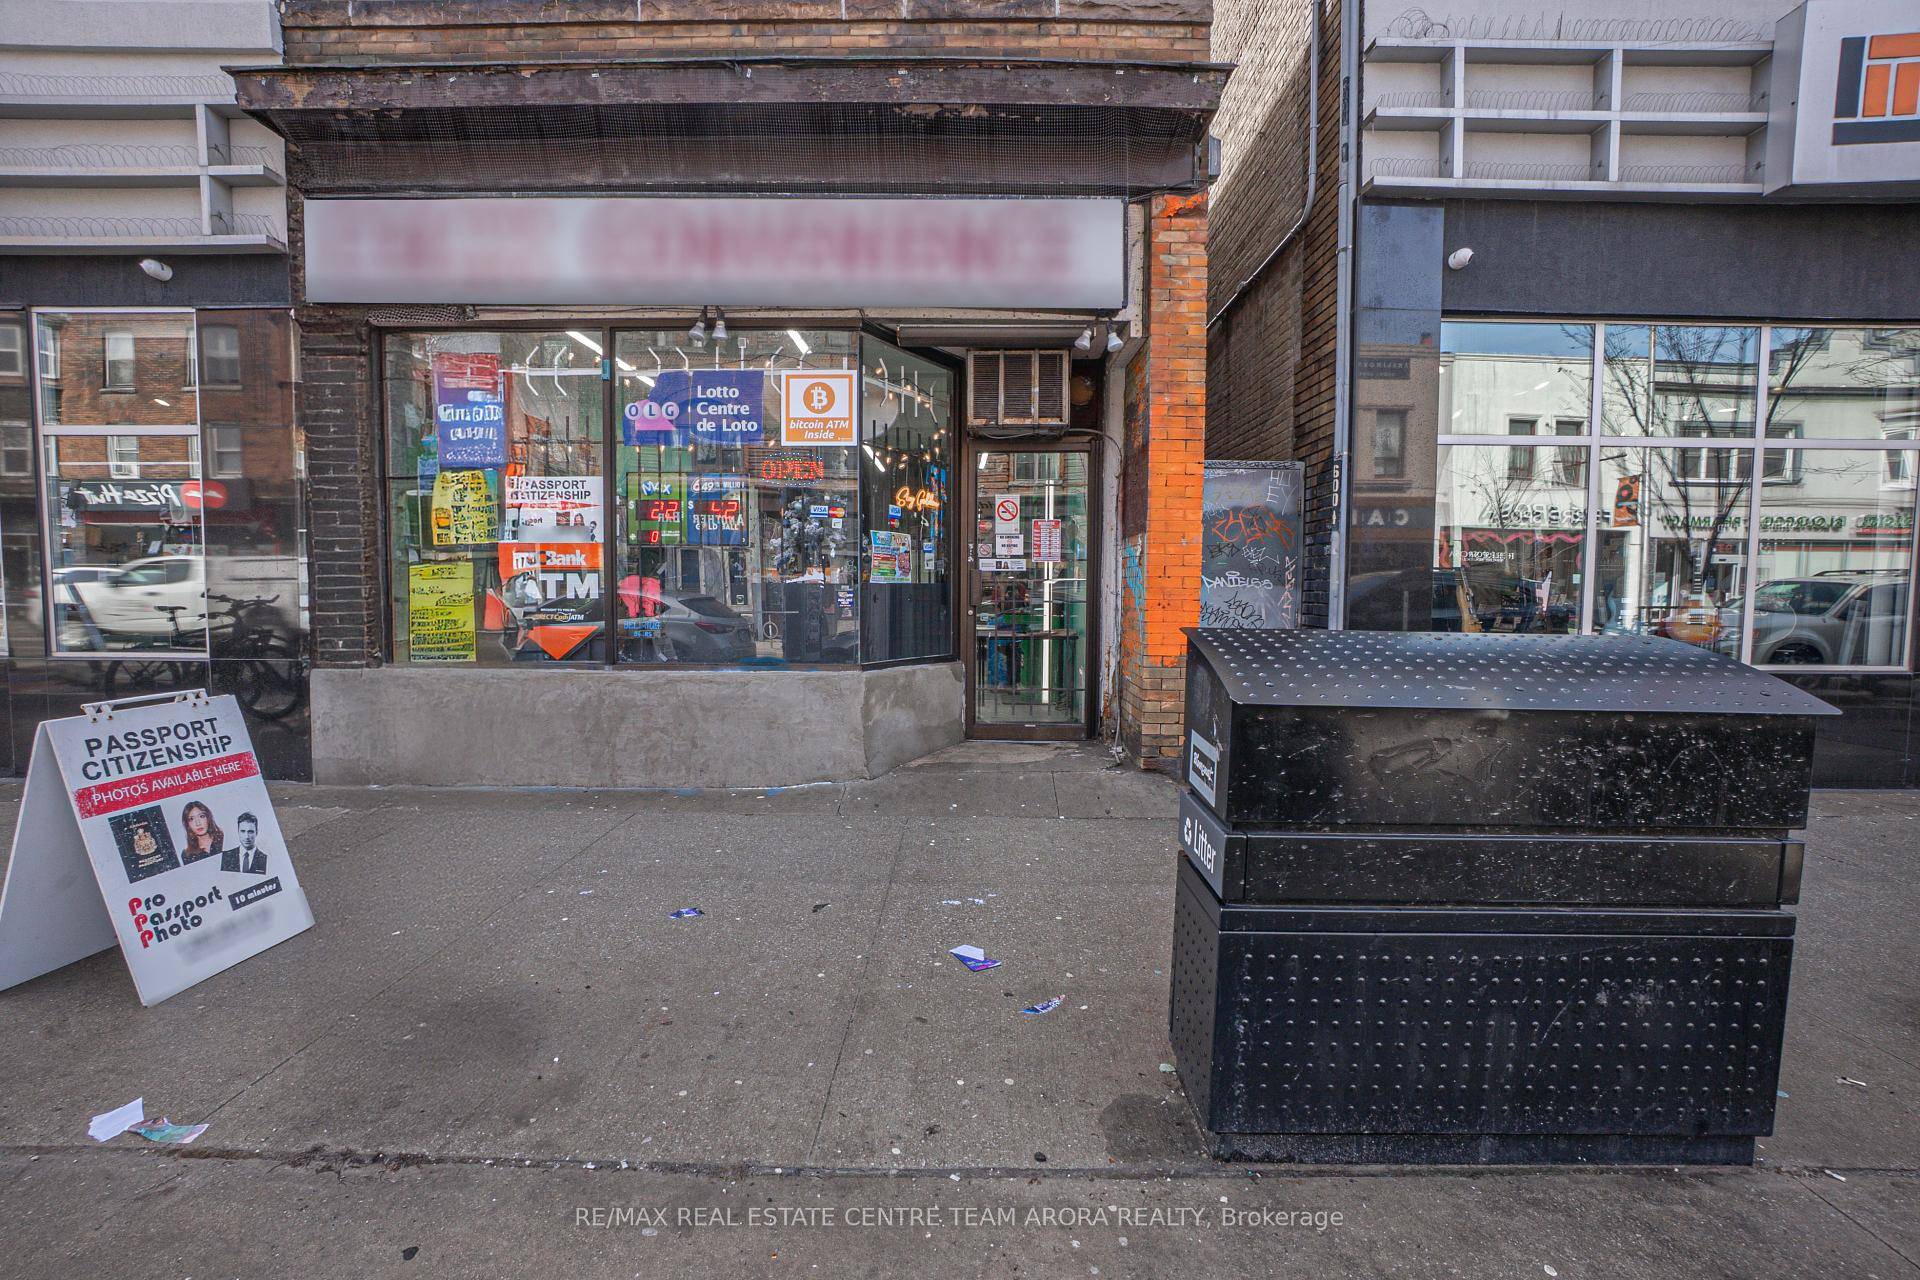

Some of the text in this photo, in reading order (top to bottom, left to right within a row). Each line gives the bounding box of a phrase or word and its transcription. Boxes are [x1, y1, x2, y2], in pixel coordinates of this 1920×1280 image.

[697, 386, 740, 398] Lotto
[627, 403, 677, 418] OLG
[697, 402, 750, 415] Centre
[697, 420, 758, 432] de Loto
[790, 420, 849, 429] bitcoin ATM
[804, 430, 835, 439] Inside
[761, 460, 824, 479] OPEN
[545, 549, 586, 566] Bank
[84, 717, 218, 758] PASSPORT
[82, 735, 232, 781] CITIZENSHIP
[93, 760, 242, 806] PHOTOS AVAILABLE HERE
[1193, 819, 1217, 875] Litter
[234, 882, 278, 904] 10 minutes
[128, 893, 166, 916] Pro
[133, 885, 223, 933] Passport
[140, 914, 203, 949] Photo
